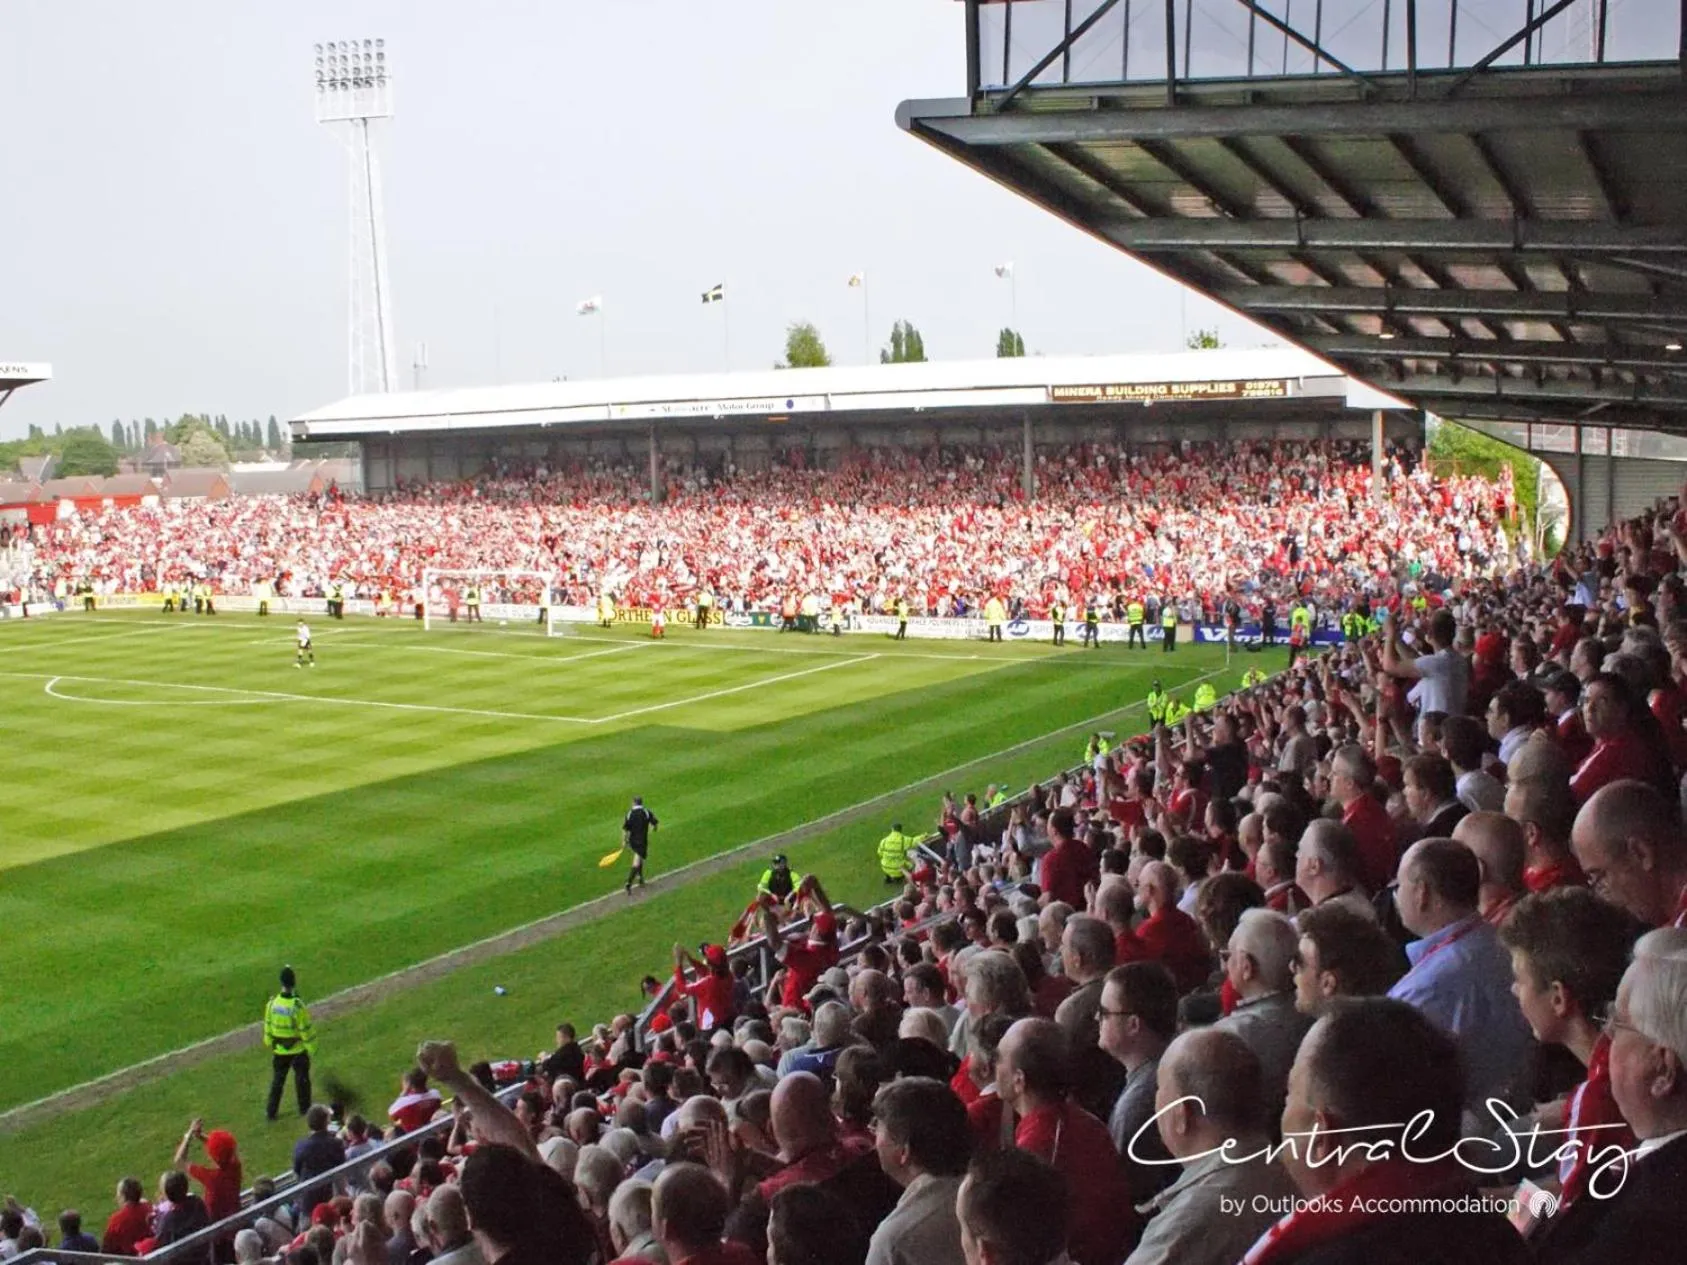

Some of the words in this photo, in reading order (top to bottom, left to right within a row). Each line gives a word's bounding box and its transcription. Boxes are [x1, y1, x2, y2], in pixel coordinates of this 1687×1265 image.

[1054, 386, 1102, 397] MINERA
[1106, 385, 1168, 396] BUILDING
[1171, 382, 1237, 394] SUPPLIES
